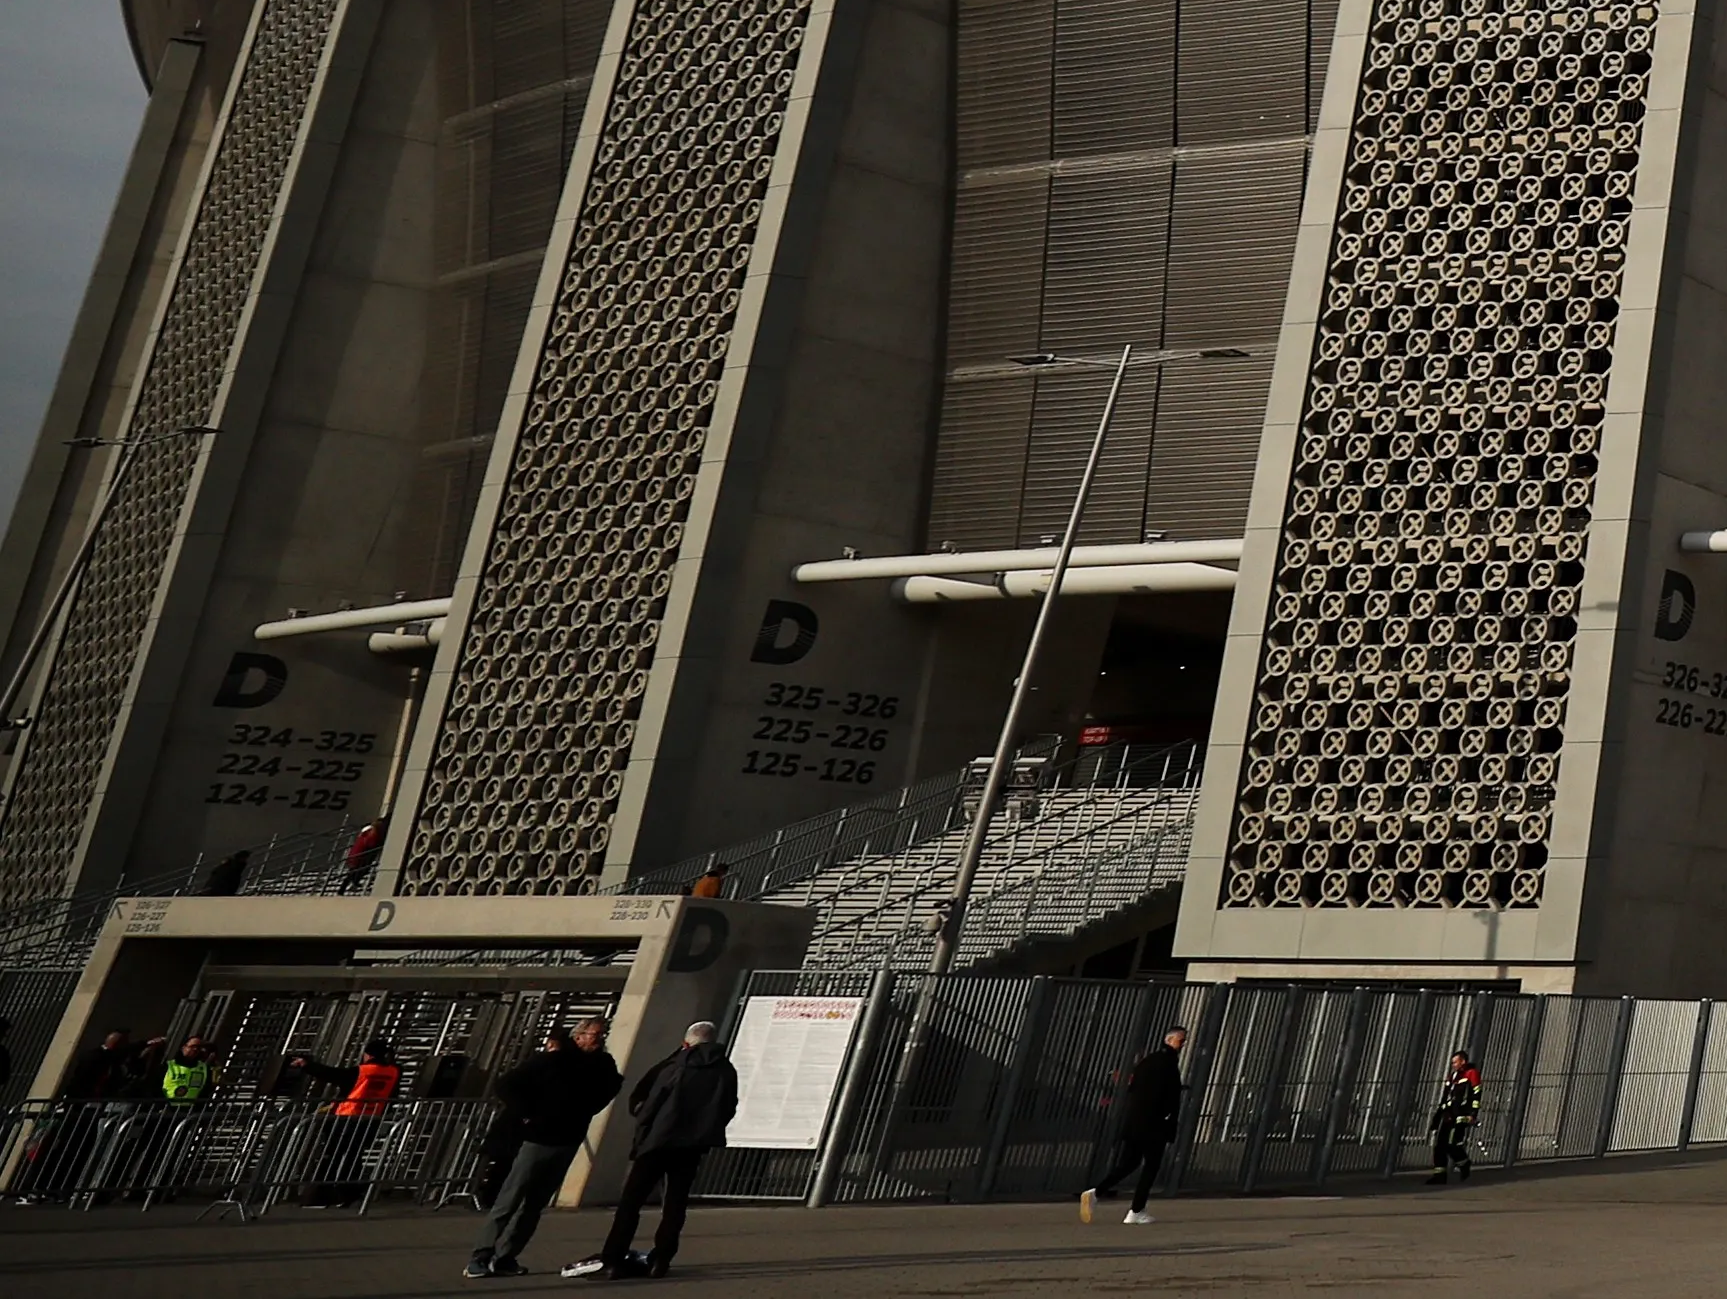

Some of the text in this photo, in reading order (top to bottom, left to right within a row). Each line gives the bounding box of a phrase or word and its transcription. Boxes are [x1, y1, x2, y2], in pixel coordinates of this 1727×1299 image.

[1654, 569, 1696, 642] D
[750, 599, 818, 665] D
[212, 652, 288, 709] D
[764, 683, 900, 719] 325-326
[228, 724, 377, 754] 324-325
[753, 717, 889, 751] 225-226
[216, 753, 365, 782] 224-225
[742, 750, 877, 784] 125-126
[204, 783, 352, 811] 124-125
[368, 900, 396, 931] D
[667, 906, 730, 973] D
